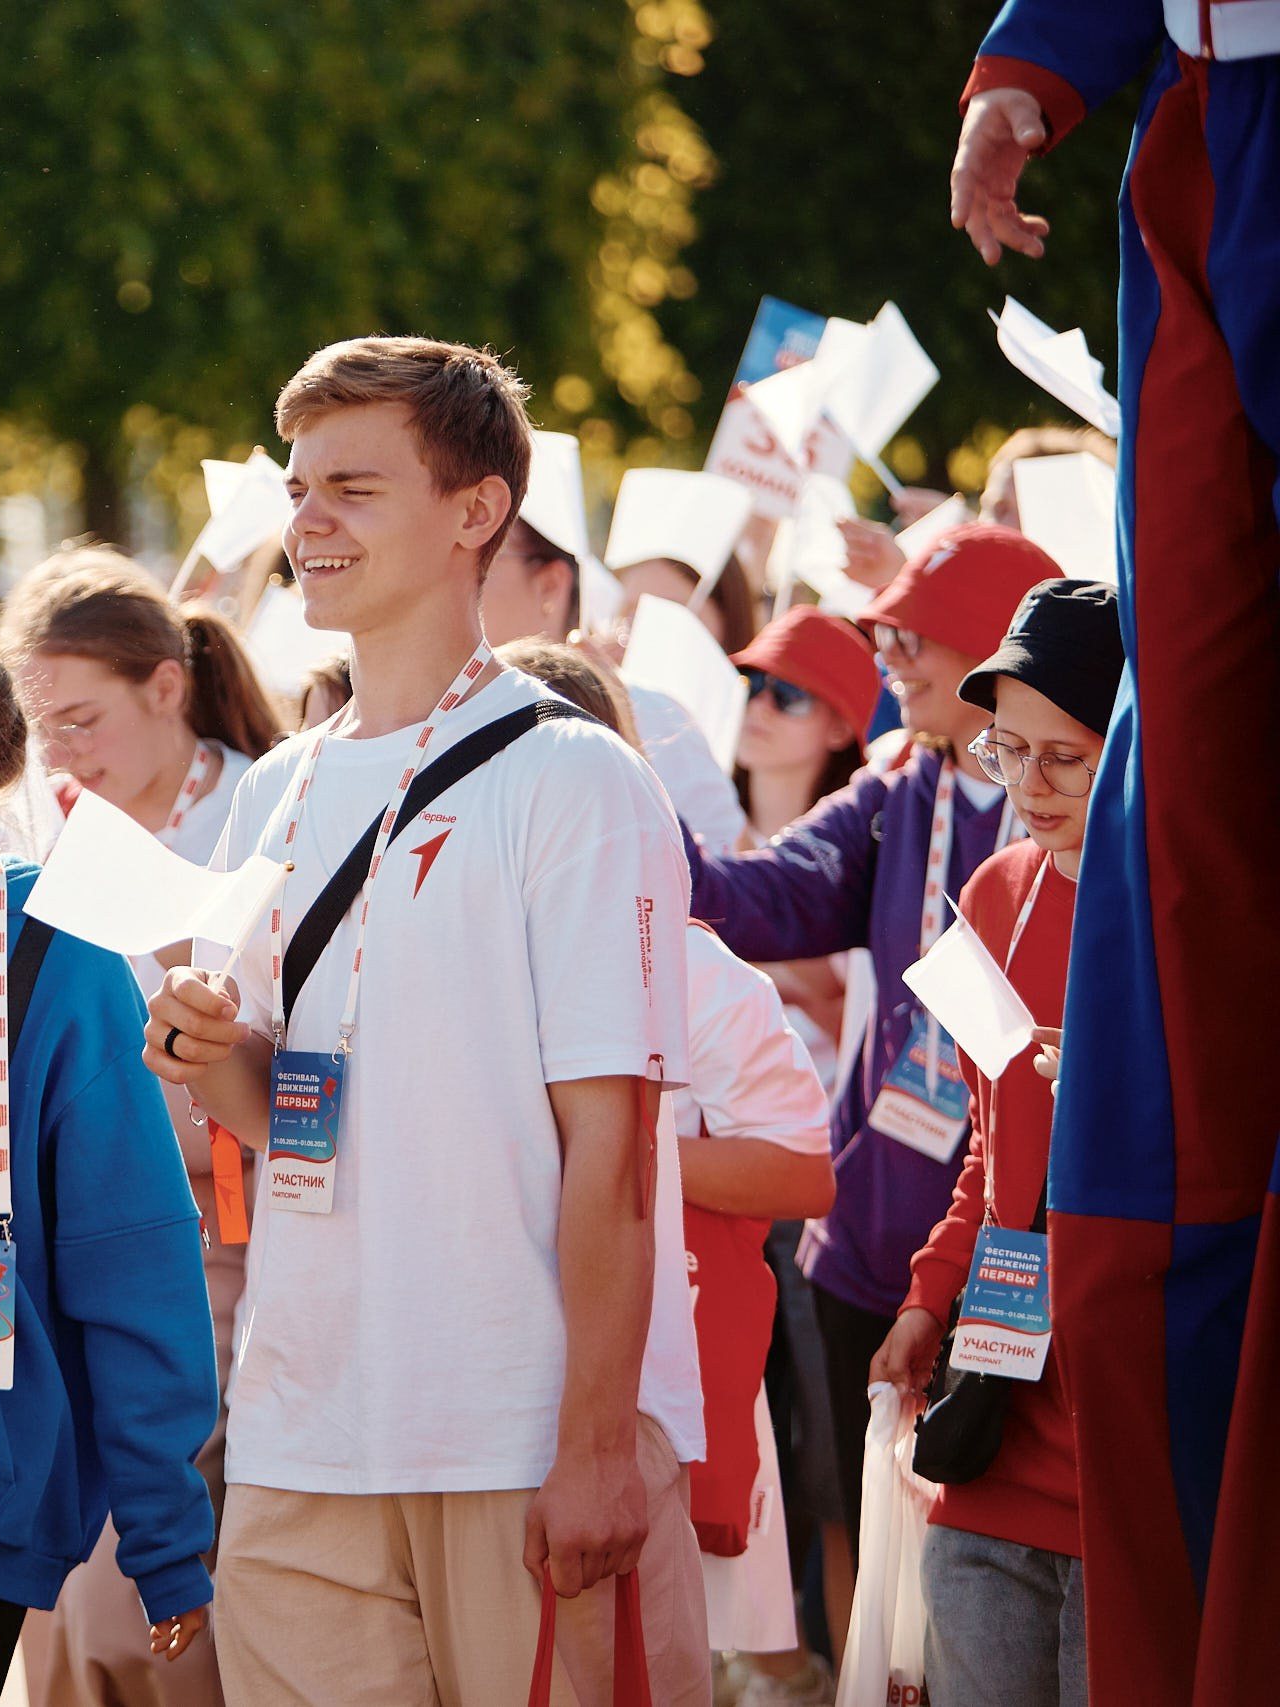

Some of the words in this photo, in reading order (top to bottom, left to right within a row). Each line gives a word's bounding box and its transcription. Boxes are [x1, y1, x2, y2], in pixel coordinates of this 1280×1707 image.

[418, 811, 457, 824] Первые
[635, 896, 644, 925] детей
[277, 1072, 320, 1083] ФЕСТИВАЛЬ
[276, 1083, 320, 1094] ДВИЖЕНИЯ
[276, 1095, 318, 1109] ПЕРВЫХ
[272, 1172, 325, 1189] УЧАСТНИК
[271, 1190, 301, 1200] PARTICIPANT
[984, 1246, 1041, 1262] ФЕСТИВАЛЬ
[981, 1256, 1039, 1272] ДВИЖЕНИЯ
[979, 1268, 1036, 1286] ПЕРВЫХ
[963, 1336, 1036, 1359] УЧАСТНИК
[958, 1352, 1003, 1366] PARTICIPANT
